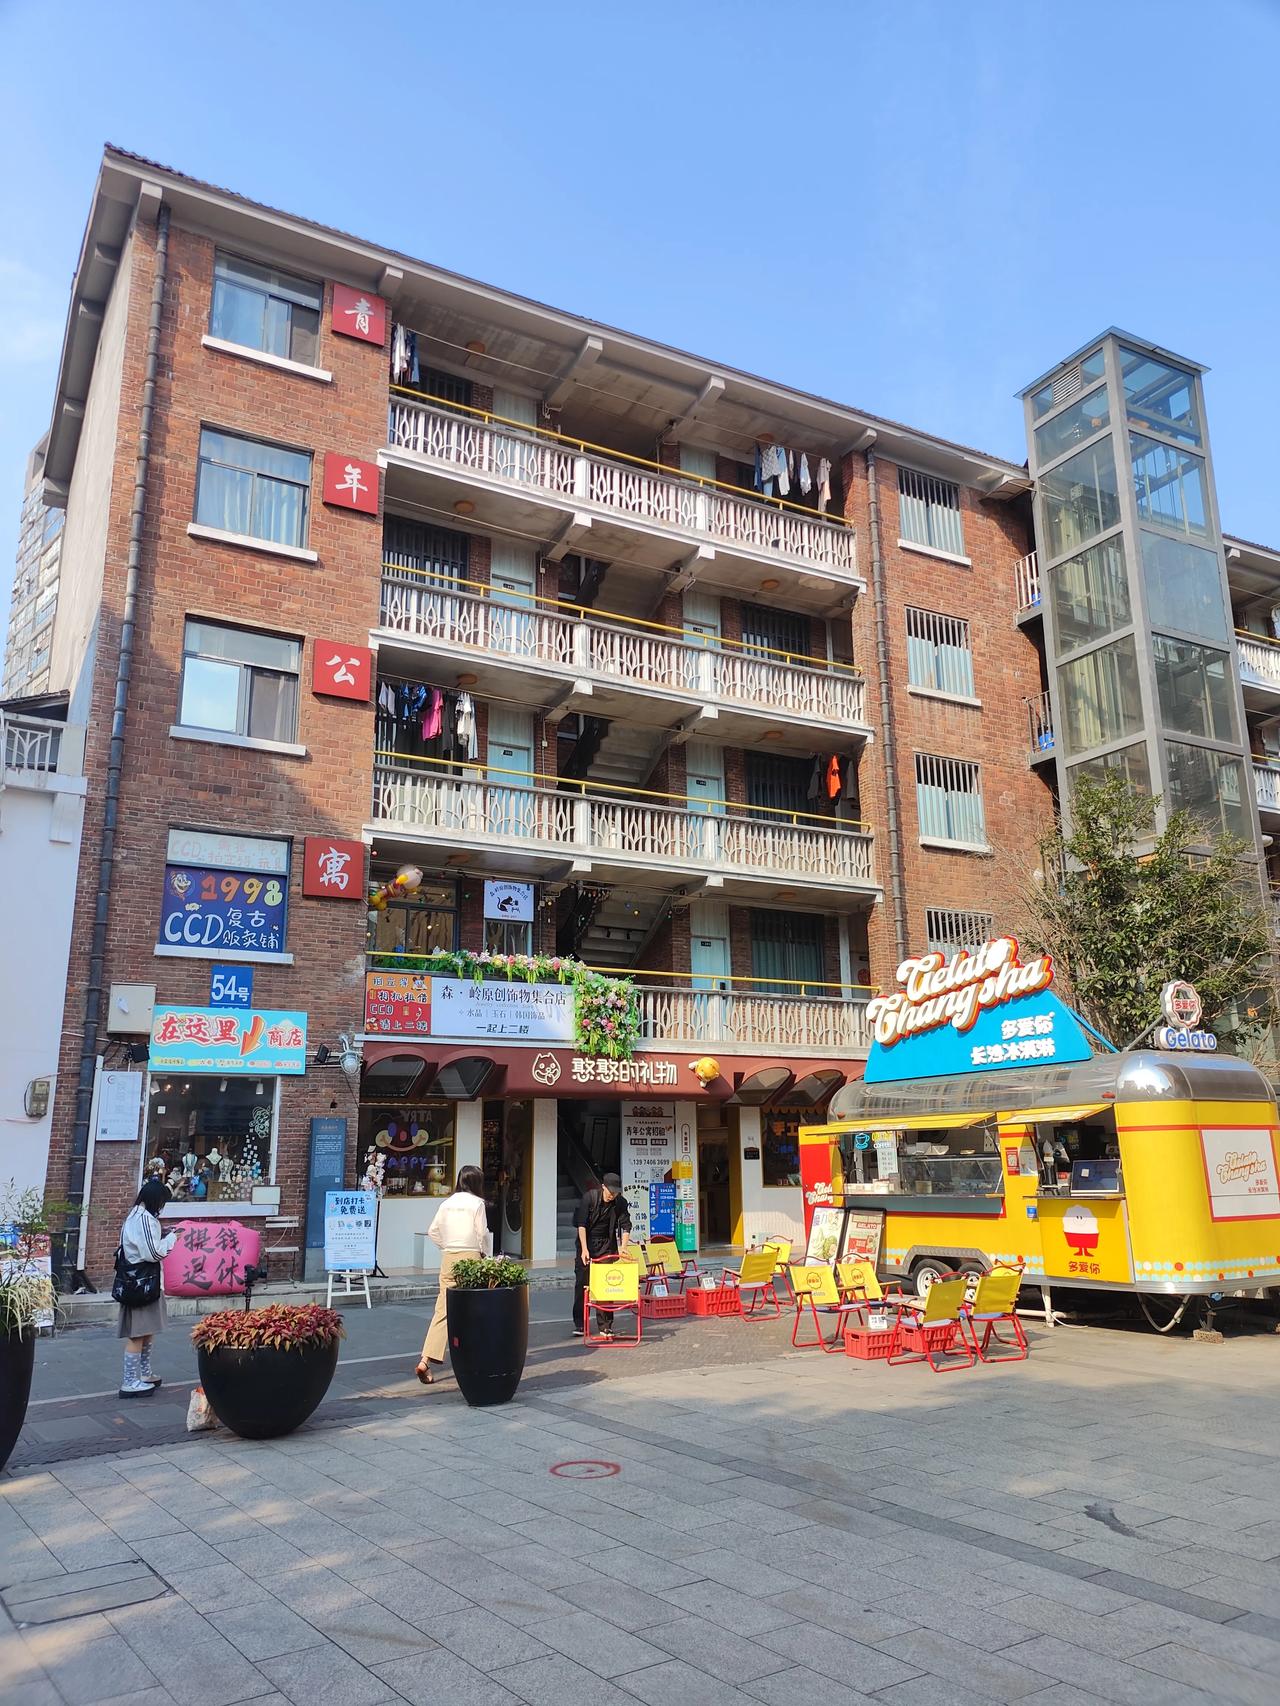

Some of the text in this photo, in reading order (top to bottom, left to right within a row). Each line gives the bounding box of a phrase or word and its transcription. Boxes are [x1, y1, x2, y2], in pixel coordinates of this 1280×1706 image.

[344, 298, 374, 335] 青
[335, 463, 368, 503] 年
[325, 655, 361, 686] 公
[318, 846, 351, 890] 寓
[201, 875, 283, 906] 1998
[164, 912, 224, 945] CCD
[226, 907, 267, 929] 复古
[222, 929, 280, 949] 贩卖铺
[895, 935, 1017, 1002] Gelato
[211, 974, 250, 1002] 54号
[370, 1004, 394, 1015] CCD
[155, 1014, 304, 1048] 在这里 商店
[476, 1023, 530, 1035] 一起上二楼
[1165, 1028, 1217, 1049] Gelato
[571, 1057, 678, 1086] 憨憨的礼物
[335, 1197, 365, 1206] 到店打卡
[340, 1205, 367, 1215] 免费送
[183, 1255, 245, 1291] 退休
[1068, 1260, 1101, 1275] 多爱你
